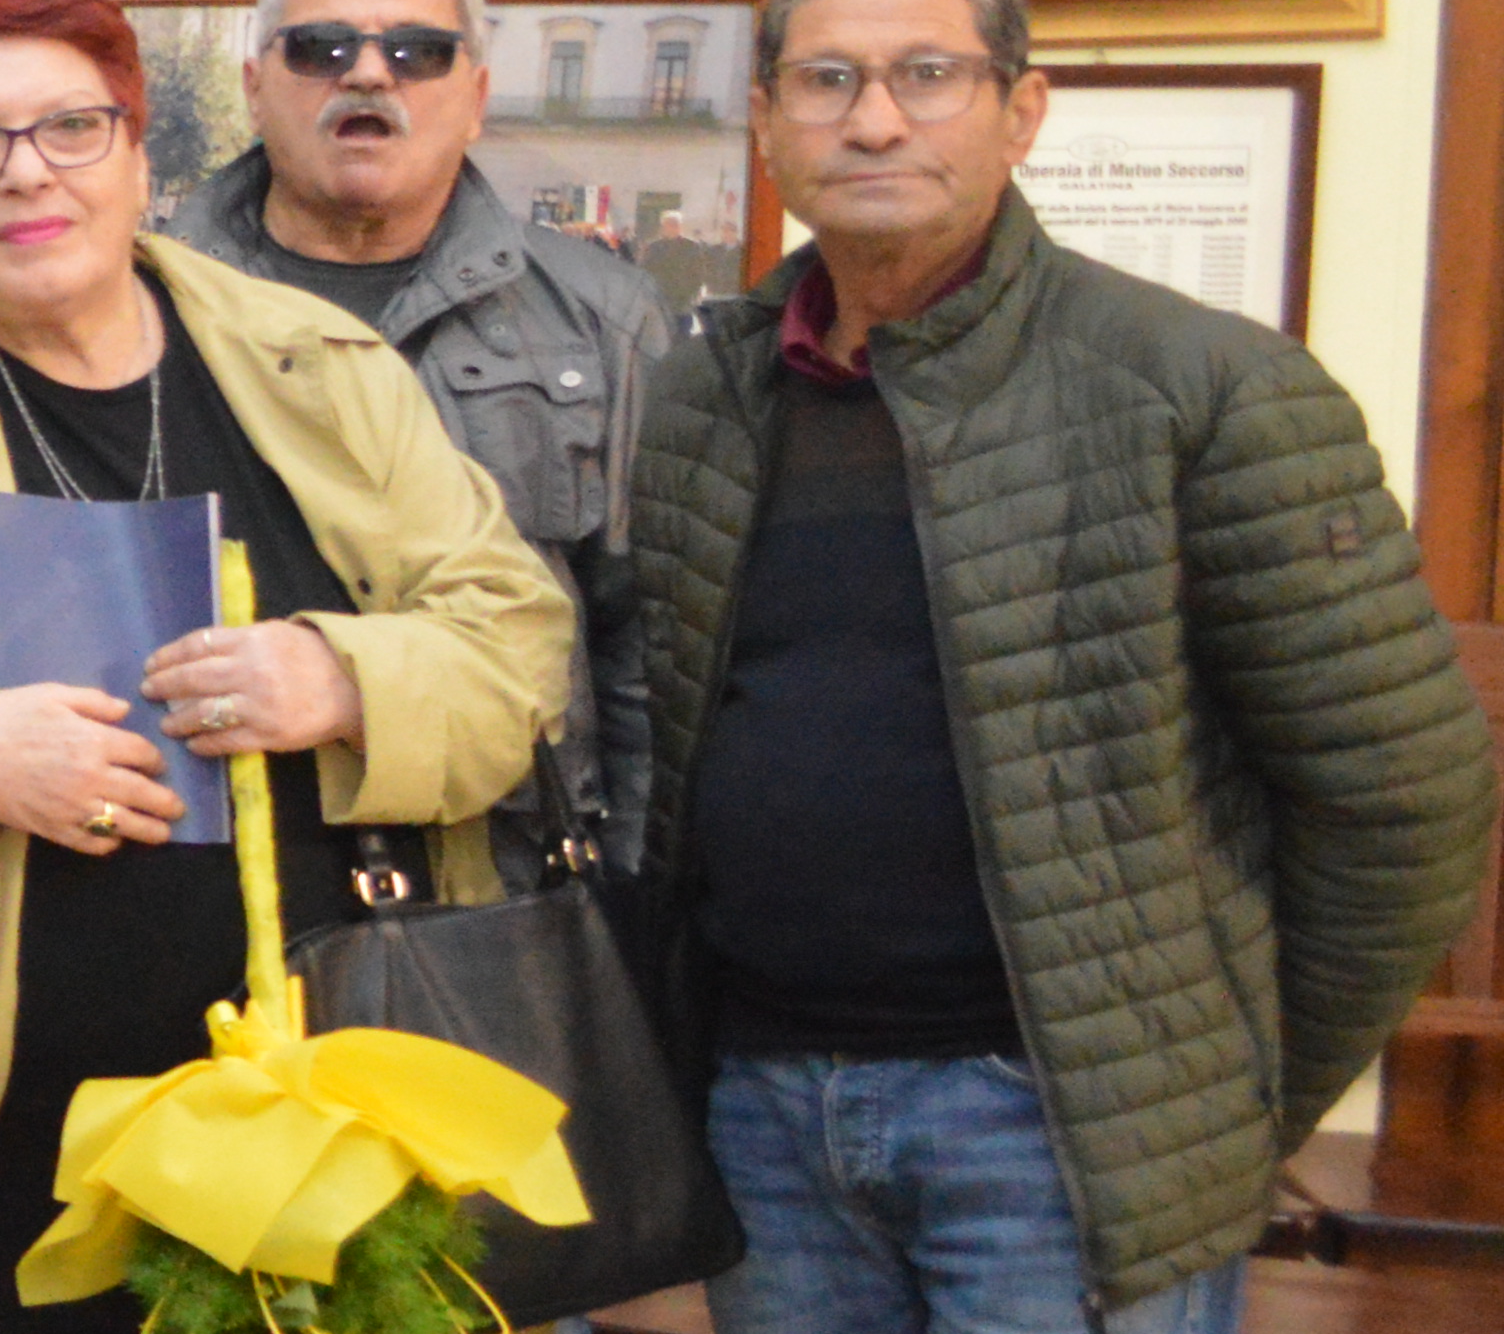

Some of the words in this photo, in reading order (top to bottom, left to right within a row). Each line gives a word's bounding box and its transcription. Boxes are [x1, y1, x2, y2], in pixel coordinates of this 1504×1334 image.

[1018, 161, 1083, 181] Operaia
[1088, 161, 1103, 178] di
[1109, 162, 1162, 178] Mutuo
[1168, 161, 1245, 179] Soccorso
